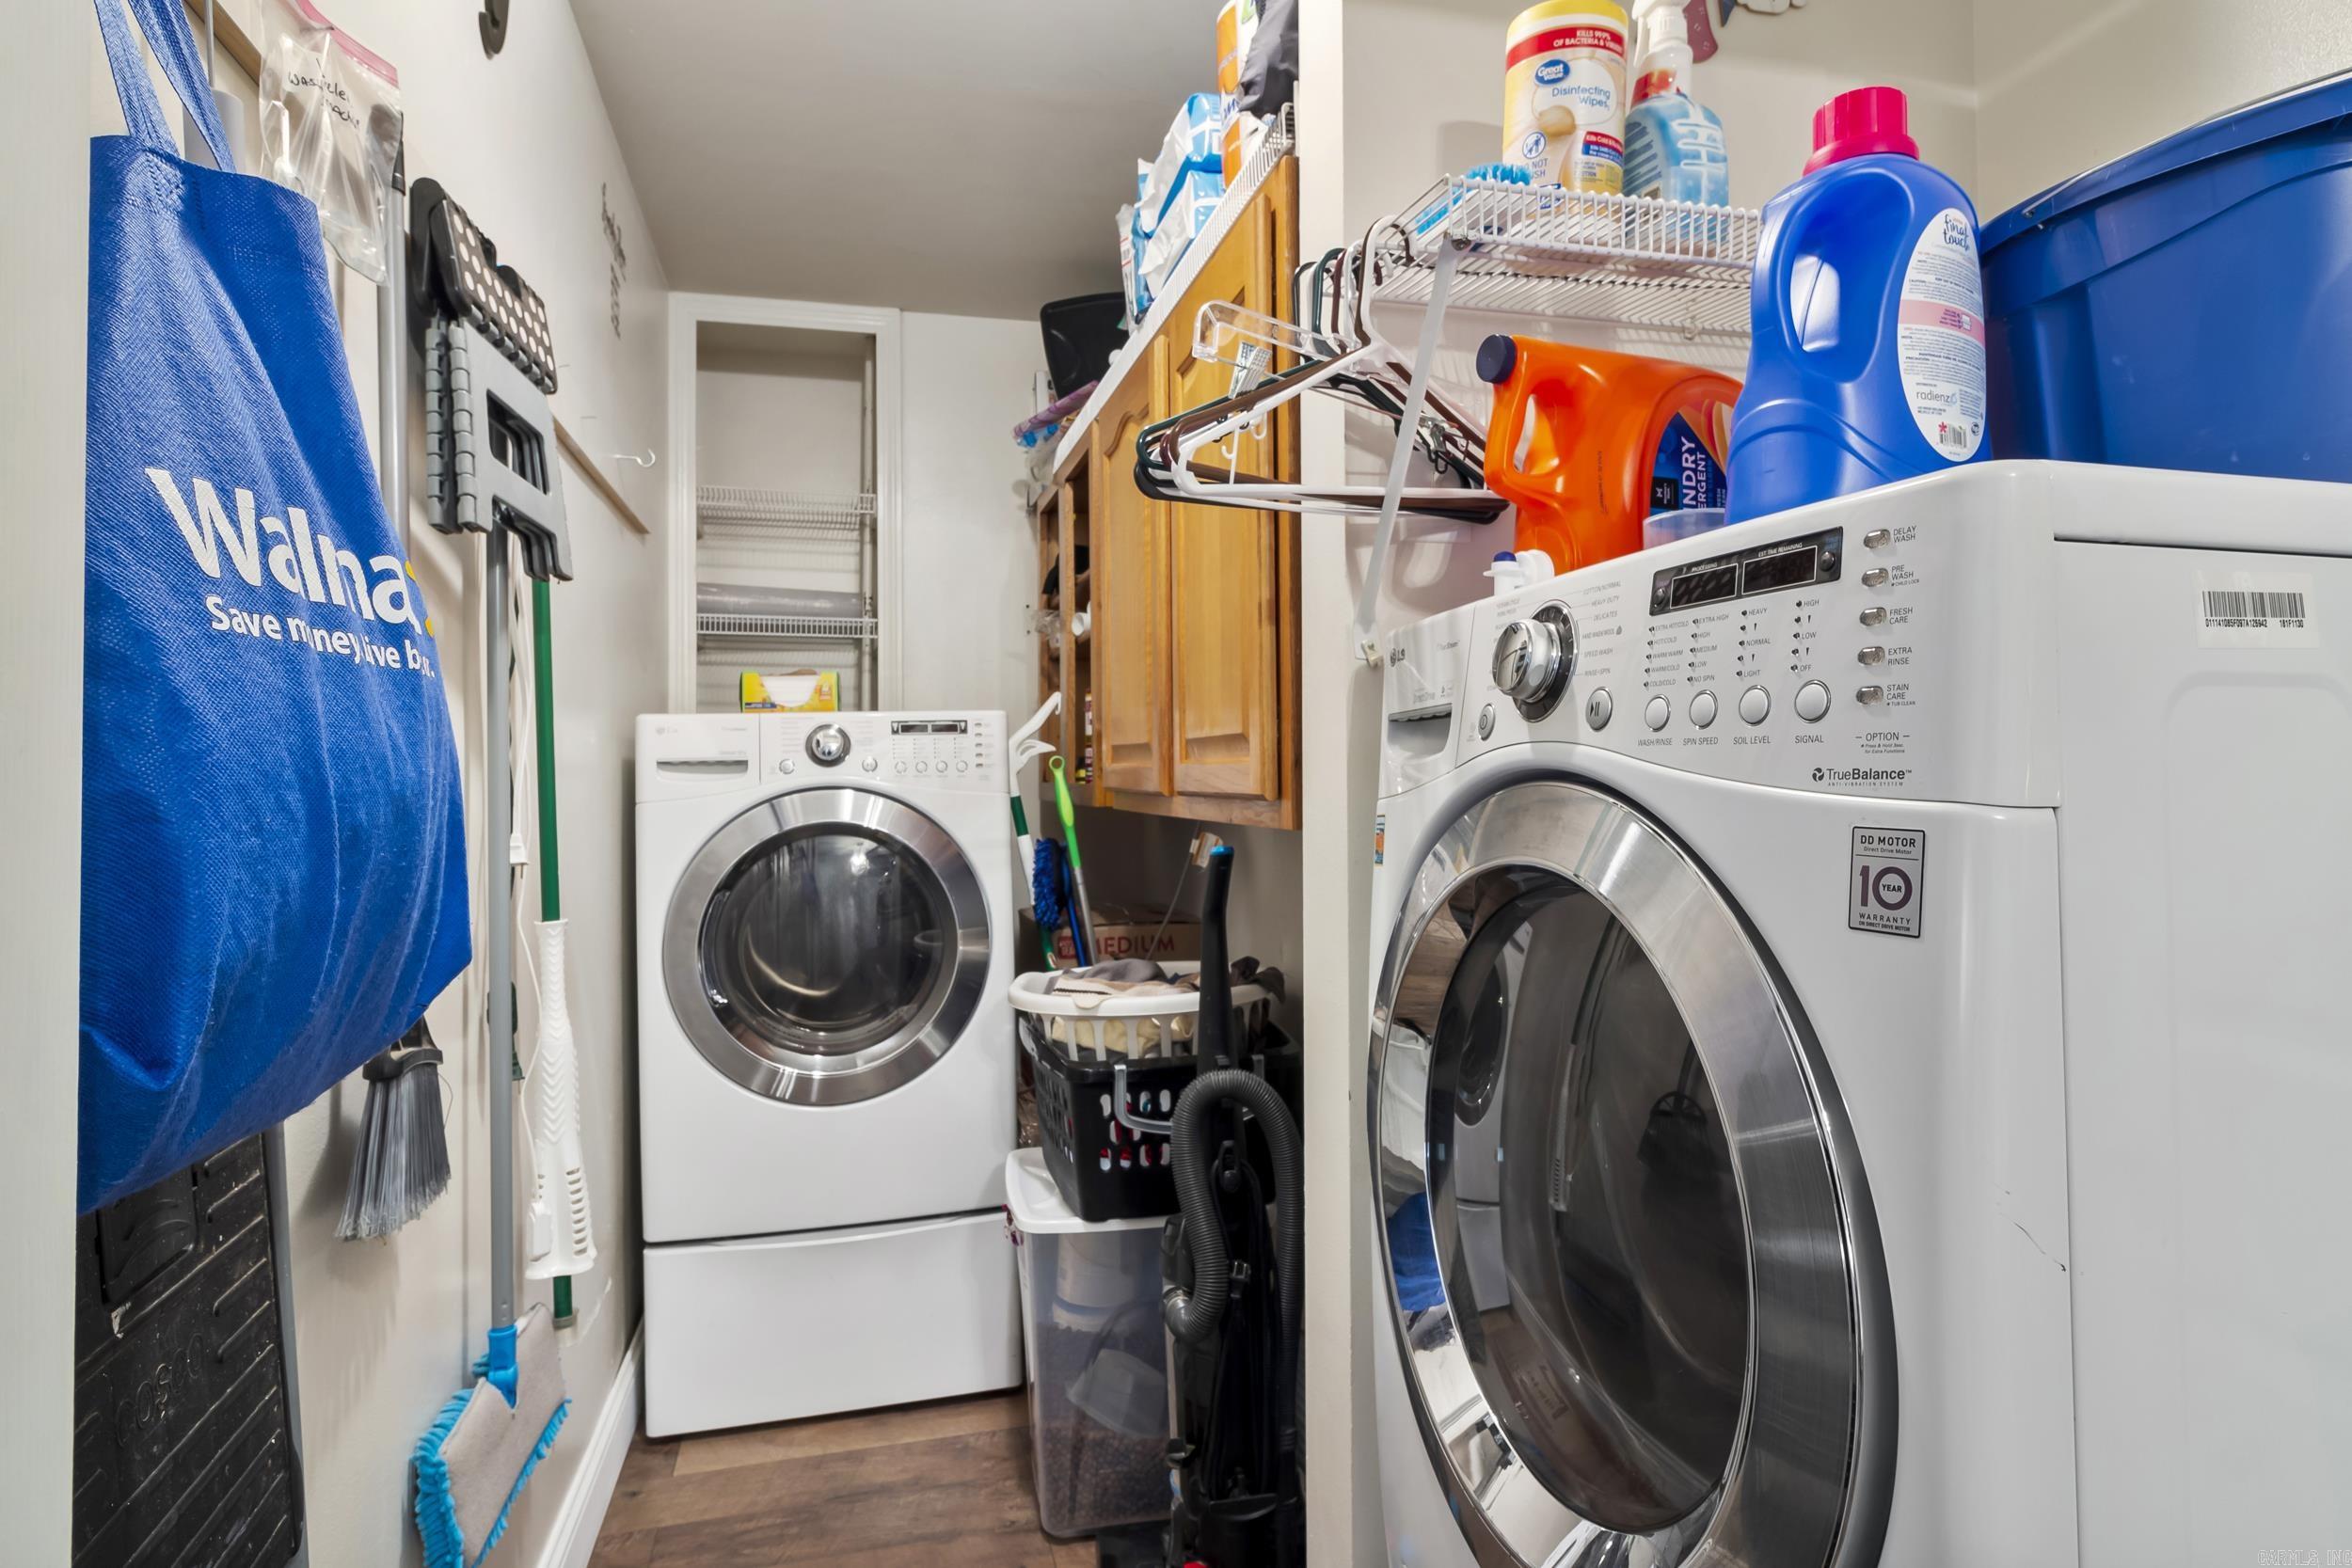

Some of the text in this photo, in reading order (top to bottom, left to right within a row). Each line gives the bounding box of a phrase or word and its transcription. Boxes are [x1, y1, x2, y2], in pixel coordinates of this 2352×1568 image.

[1551, 85, 1611, 100] Disinfecting
[1580, 96, 1607, 107] Wipes
[1916, 390, 1950, 404] radienz
[1680, 436, 1696, 506] NDRY
[1893, 526, 1916, 536] DELAY
[1893, 534, 1916, 543] WASH
[1891, 572, 1914, 580] WASH
[1804, 599, 1820, 608] HIGH
[1748, 608, 1768, 616] HEAVY
[1889, 607, 1914, 616] FRESH
[205, 594, 282, 641] Save
[1699, 616, 1715, 625] EXTRA
[1889, 616, 1909, 626] CARE
[1746, 639, 1771, 647] NORMAL
[1887, 646, 1913, 657] EXTRA
[1887, 657, 1910, 667] RINSE
[1743, 670, 1761, 678] LIGHT
[1886, 683, 1910, 692] STAIN
[1886, 692, 1906, 701] CARE
[1682, 736, 1719, 746] SPIN SPEED
[1733, 736, 1771, 745] SOIL LEVEL
[1794, 735, 1824, 744] SIGNAL
[1866, 732, 1899, 742] OPTION
[1861, 835, 1916, 847] DD MOTOR
[1859, 865, 1913, 911] 10
[1882, 883, 1902, 893] YEAR
[1859, 912, 1911, 925] WARRANTY
